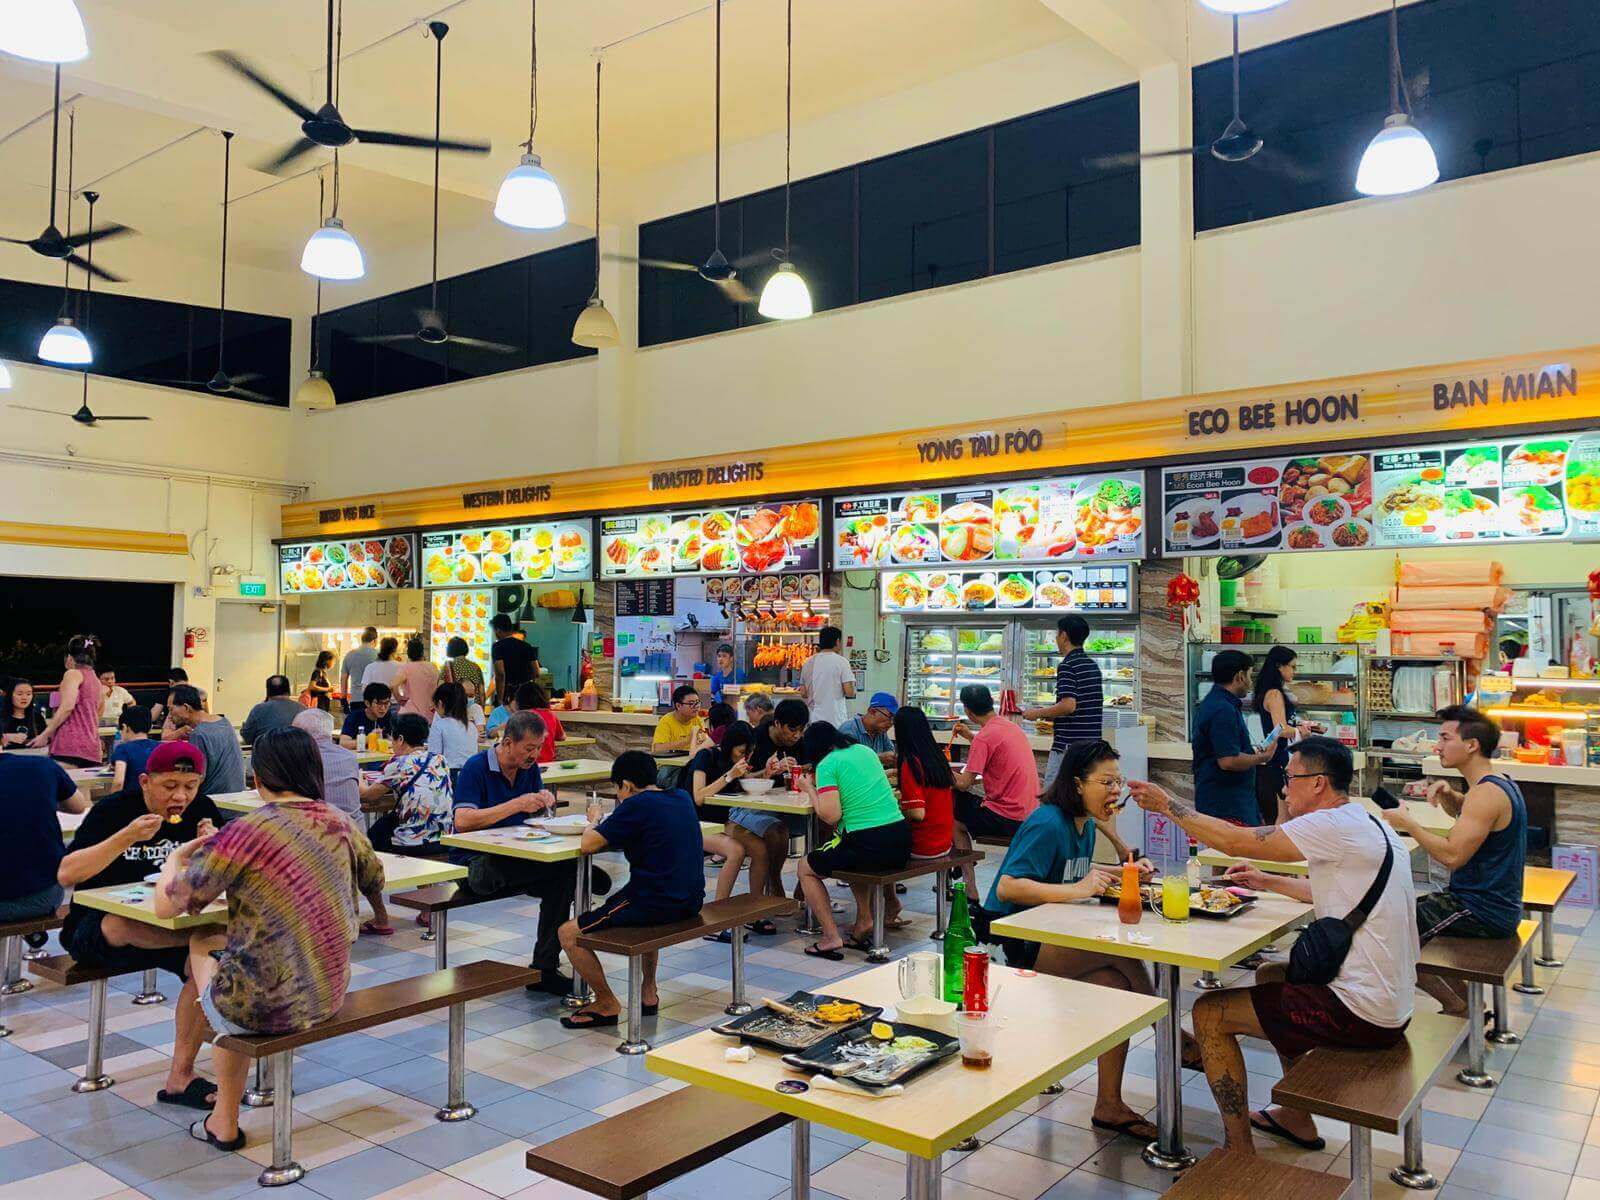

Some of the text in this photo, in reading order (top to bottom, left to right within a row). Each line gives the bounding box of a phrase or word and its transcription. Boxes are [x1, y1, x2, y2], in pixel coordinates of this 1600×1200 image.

[1433, 368, 1577, 411] BAN MIAN
[1188, 393, 1359, 436] ECO BEE HOON
[917, 428, 1042, 462] YONG TAU FOO
[651, 461, 764, 490] ROASTED DELIGHTS
[1206, 480, 1220, 488] Bee
[505, 484, 552, 505] DELIGHTS
[245, 585, 262, 594] EXIT
